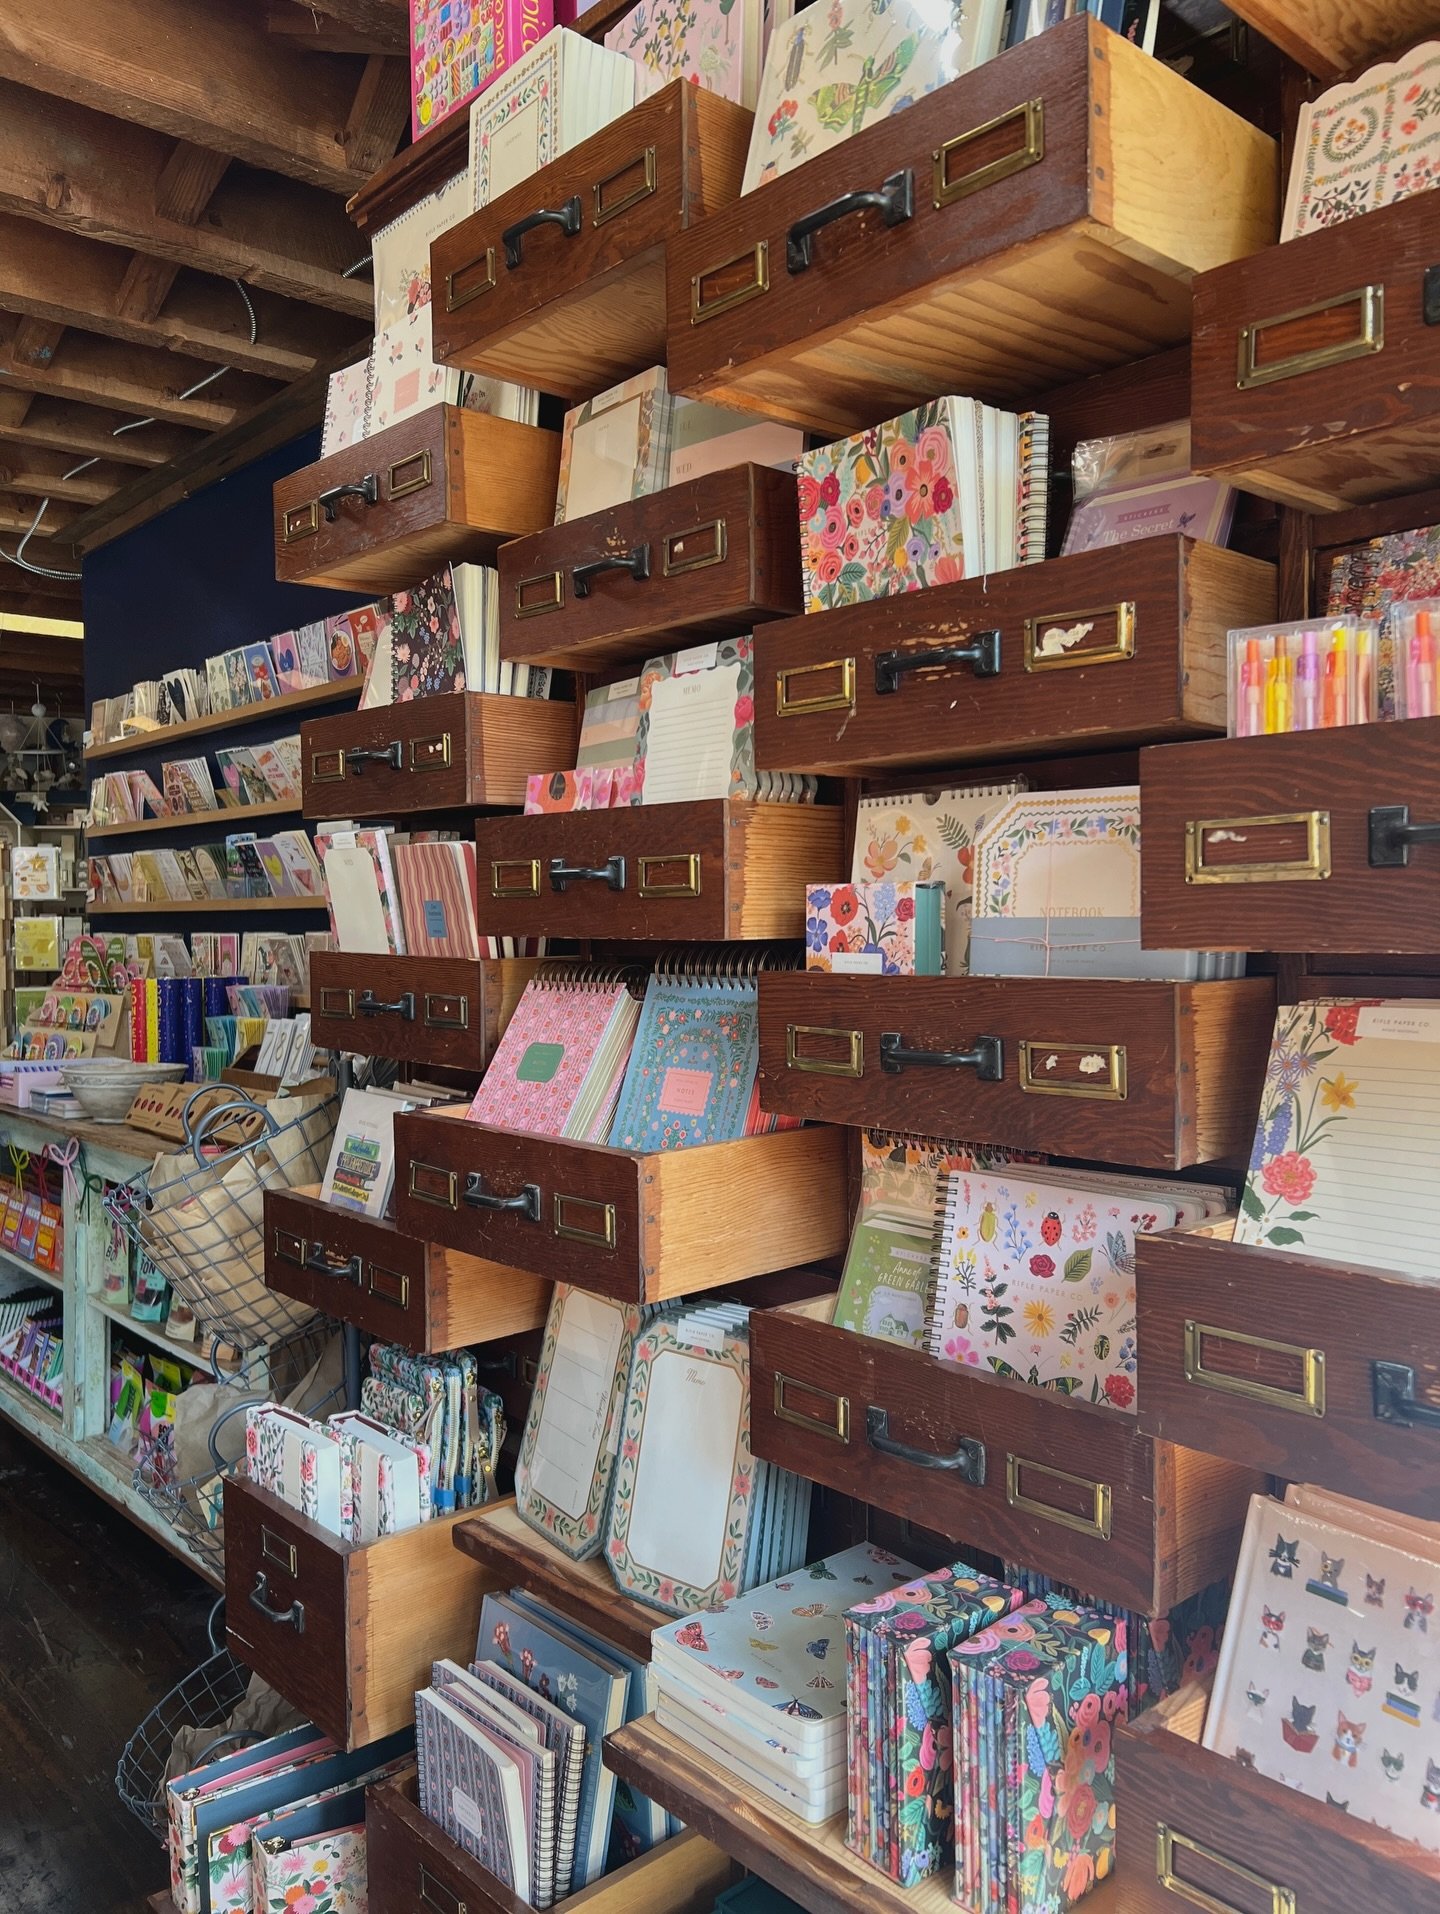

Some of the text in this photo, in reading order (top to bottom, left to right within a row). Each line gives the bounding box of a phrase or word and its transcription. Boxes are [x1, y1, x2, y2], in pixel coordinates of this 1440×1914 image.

[675, 462, 693, 475] WED
[1103, 519, 1175, 543] The Secret
[683, 684, 702, 695] MEMO
[1040, 906, 1105, 917] NOTEBOOK
[275, 1031, 287, 1062] 8
[290, 1032, 304, 1073] 9
[877, 1272, 904, 1288] GREEN
[892, 1261, 923, 1282] Anne of
[1011, 1279, 1035, 1290] RIFLE
[1040, 1285, 1066, 1297] PAPER
[686, 1366, 706, 1386] Memo
